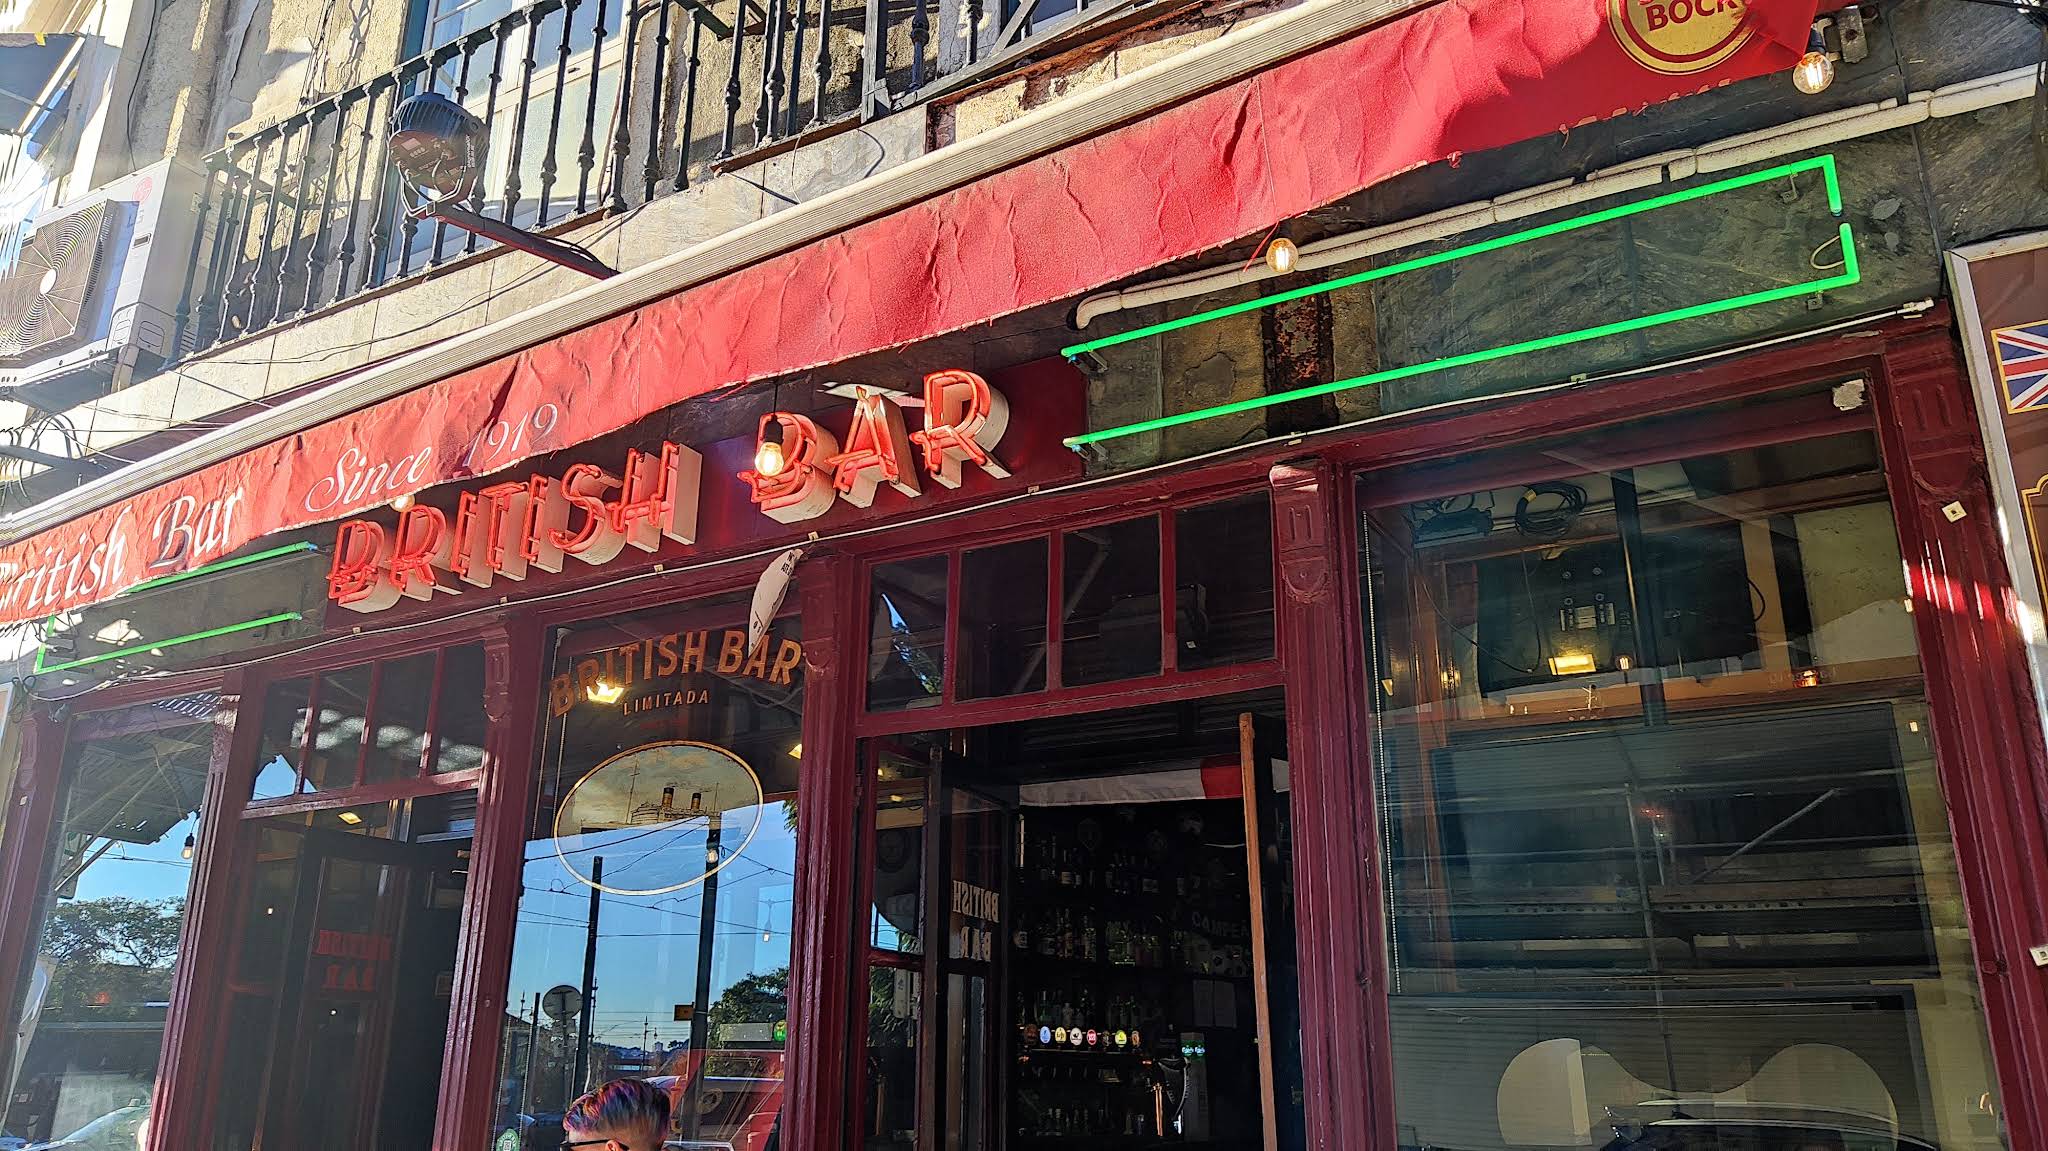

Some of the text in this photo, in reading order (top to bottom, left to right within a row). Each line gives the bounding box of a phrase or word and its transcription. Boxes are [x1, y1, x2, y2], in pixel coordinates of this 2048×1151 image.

[304, 403, 558, 512] Since 1919
[326, 369, 1011, 612] BRITISH BAR
[150, 487, 243, 568] Bar
[550, 630, 803, 718] BRITISH BAR
[623, 688, 711, 716] LIMITADA
